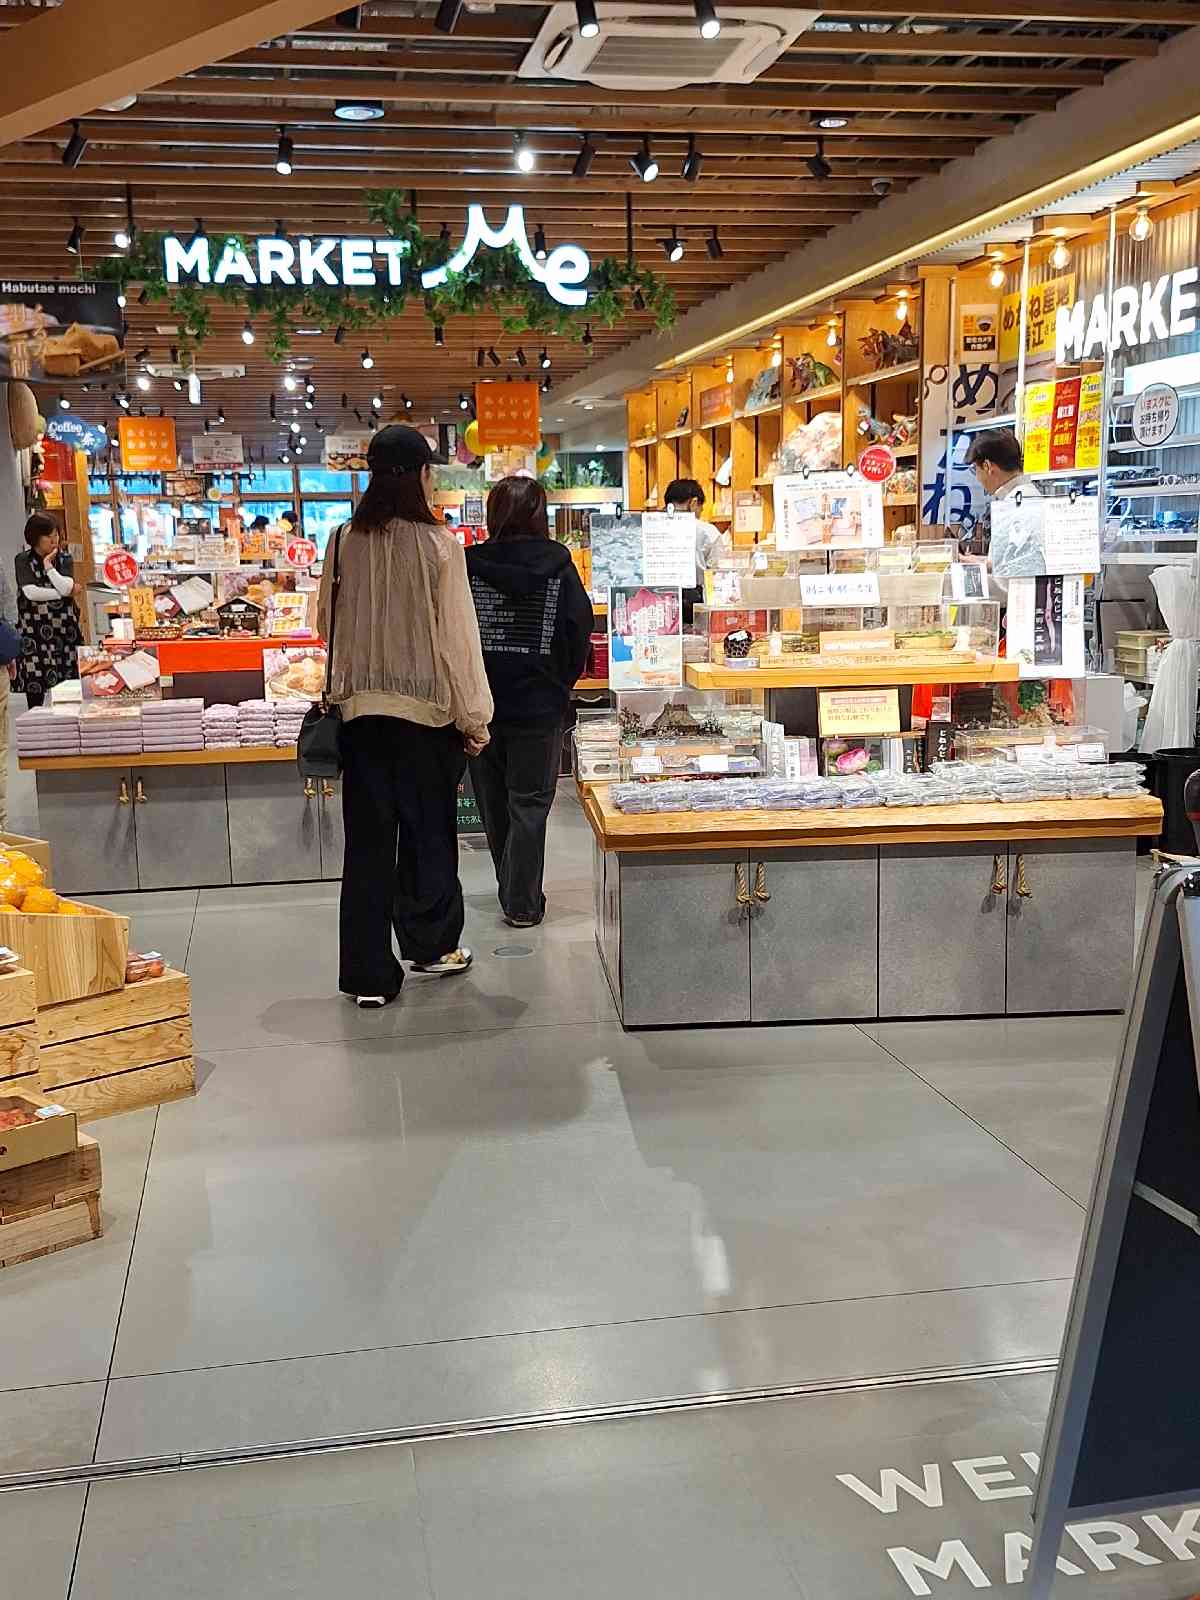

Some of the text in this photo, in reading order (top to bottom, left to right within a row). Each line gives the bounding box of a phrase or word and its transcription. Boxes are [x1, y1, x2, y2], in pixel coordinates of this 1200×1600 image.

[164, 204, 590, 306] MARKET Me
[1, 282, 96, 294] Habutae mochi
[1056, 267, 1199, 365] MARKE
[48, 422, 82, 433] Coffee
